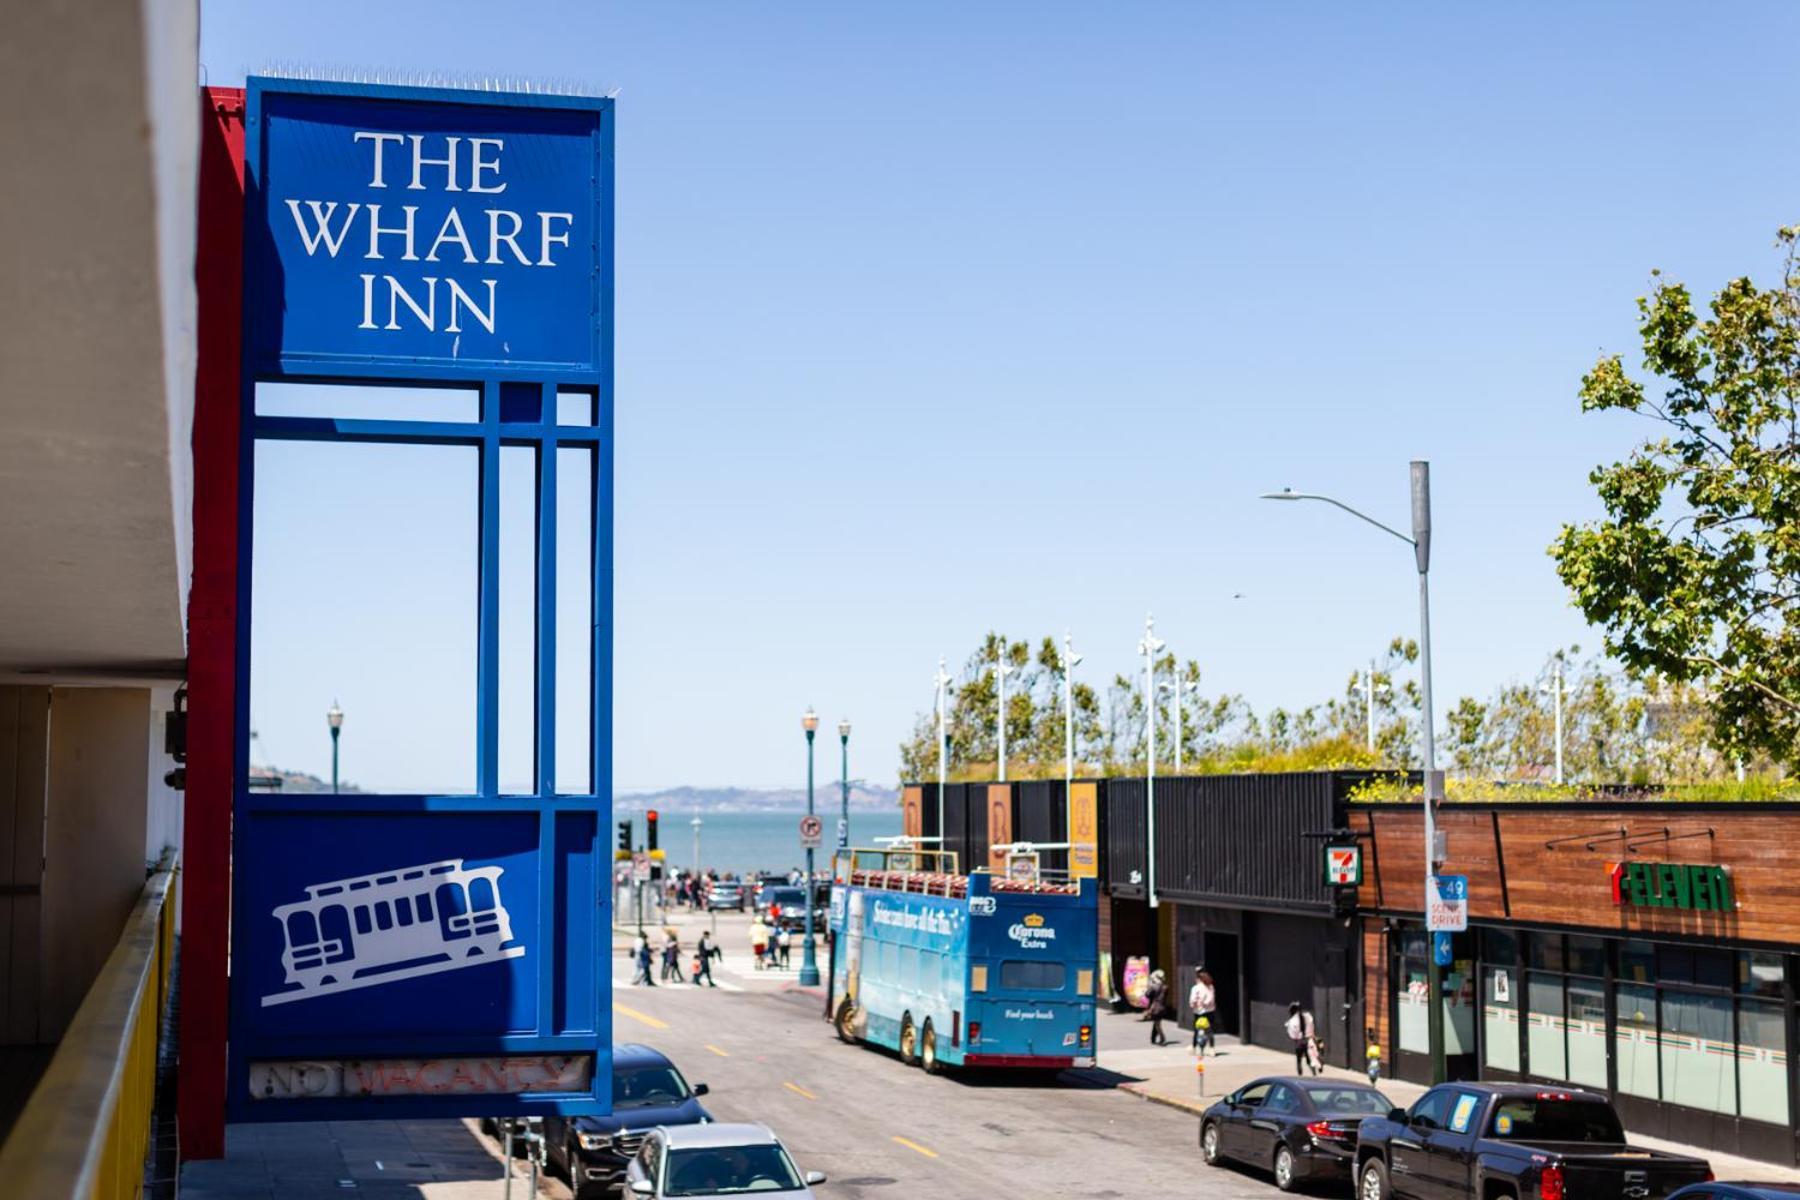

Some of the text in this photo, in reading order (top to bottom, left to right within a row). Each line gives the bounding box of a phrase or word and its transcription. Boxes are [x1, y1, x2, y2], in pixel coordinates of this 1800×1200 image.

[354, 131, 507, 194] THE
[285, 199, 573, 267] WHARF
[357, 273, 498, 335] INN
[1333, 851, 1353, 883] 7
[1447, 881, 1464, 896] 49
[1008, 923, 1056, 941] Corona
[1431, 914, 1462, 926] DRIVE
[1021, 939, 1047, 949] Extra
[268, 1056, 574, 1094] NO VACANCY
